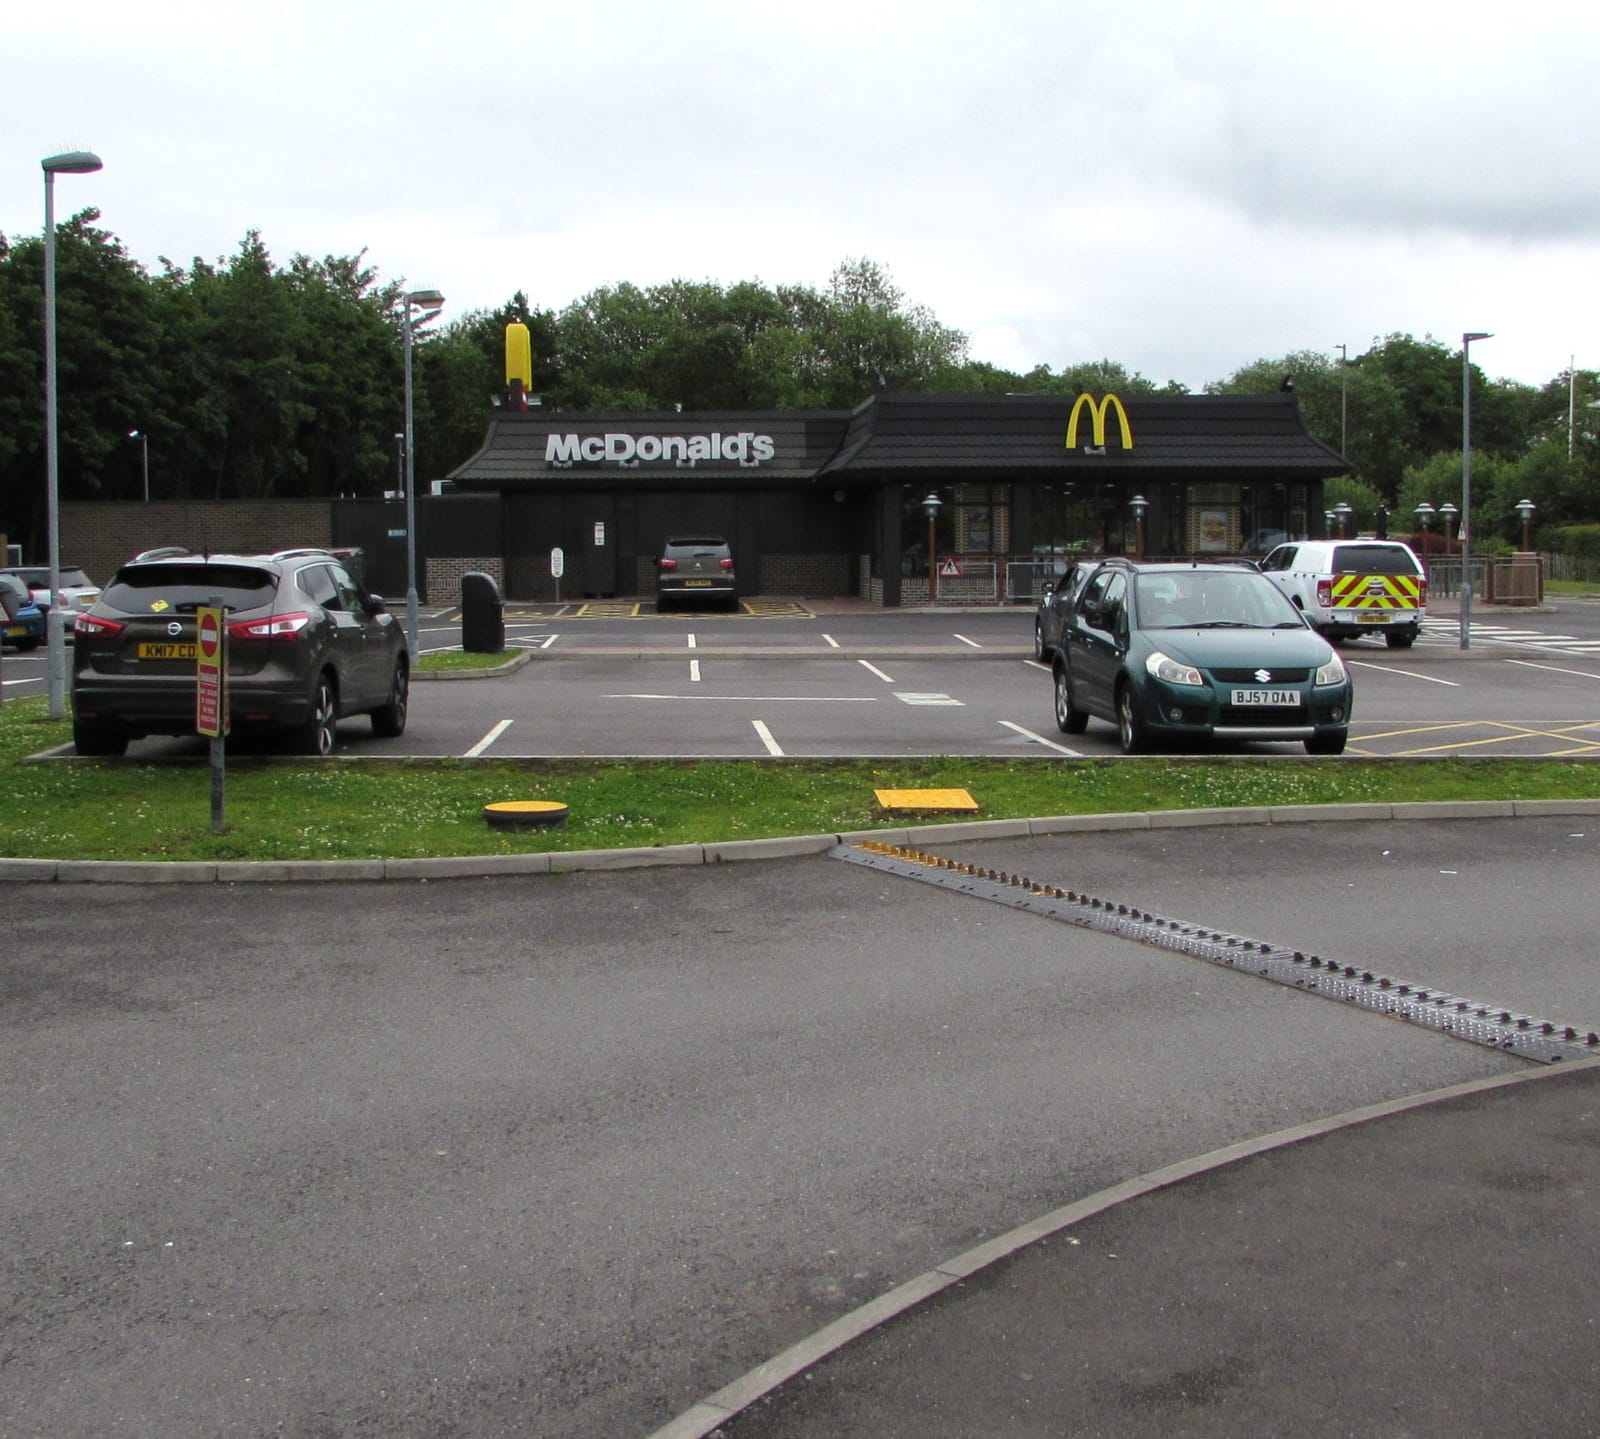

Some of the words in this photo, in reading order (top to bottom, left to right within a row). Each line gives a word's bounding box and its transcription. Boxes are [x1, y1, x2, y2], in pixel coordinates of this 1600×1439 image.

[545, 432, 775, 461] McDonald's
[178, 644, 199, 657] CD
[1236, 691, 1269, 703] BJ57
[1271, 691, 1296, 703] OAA
